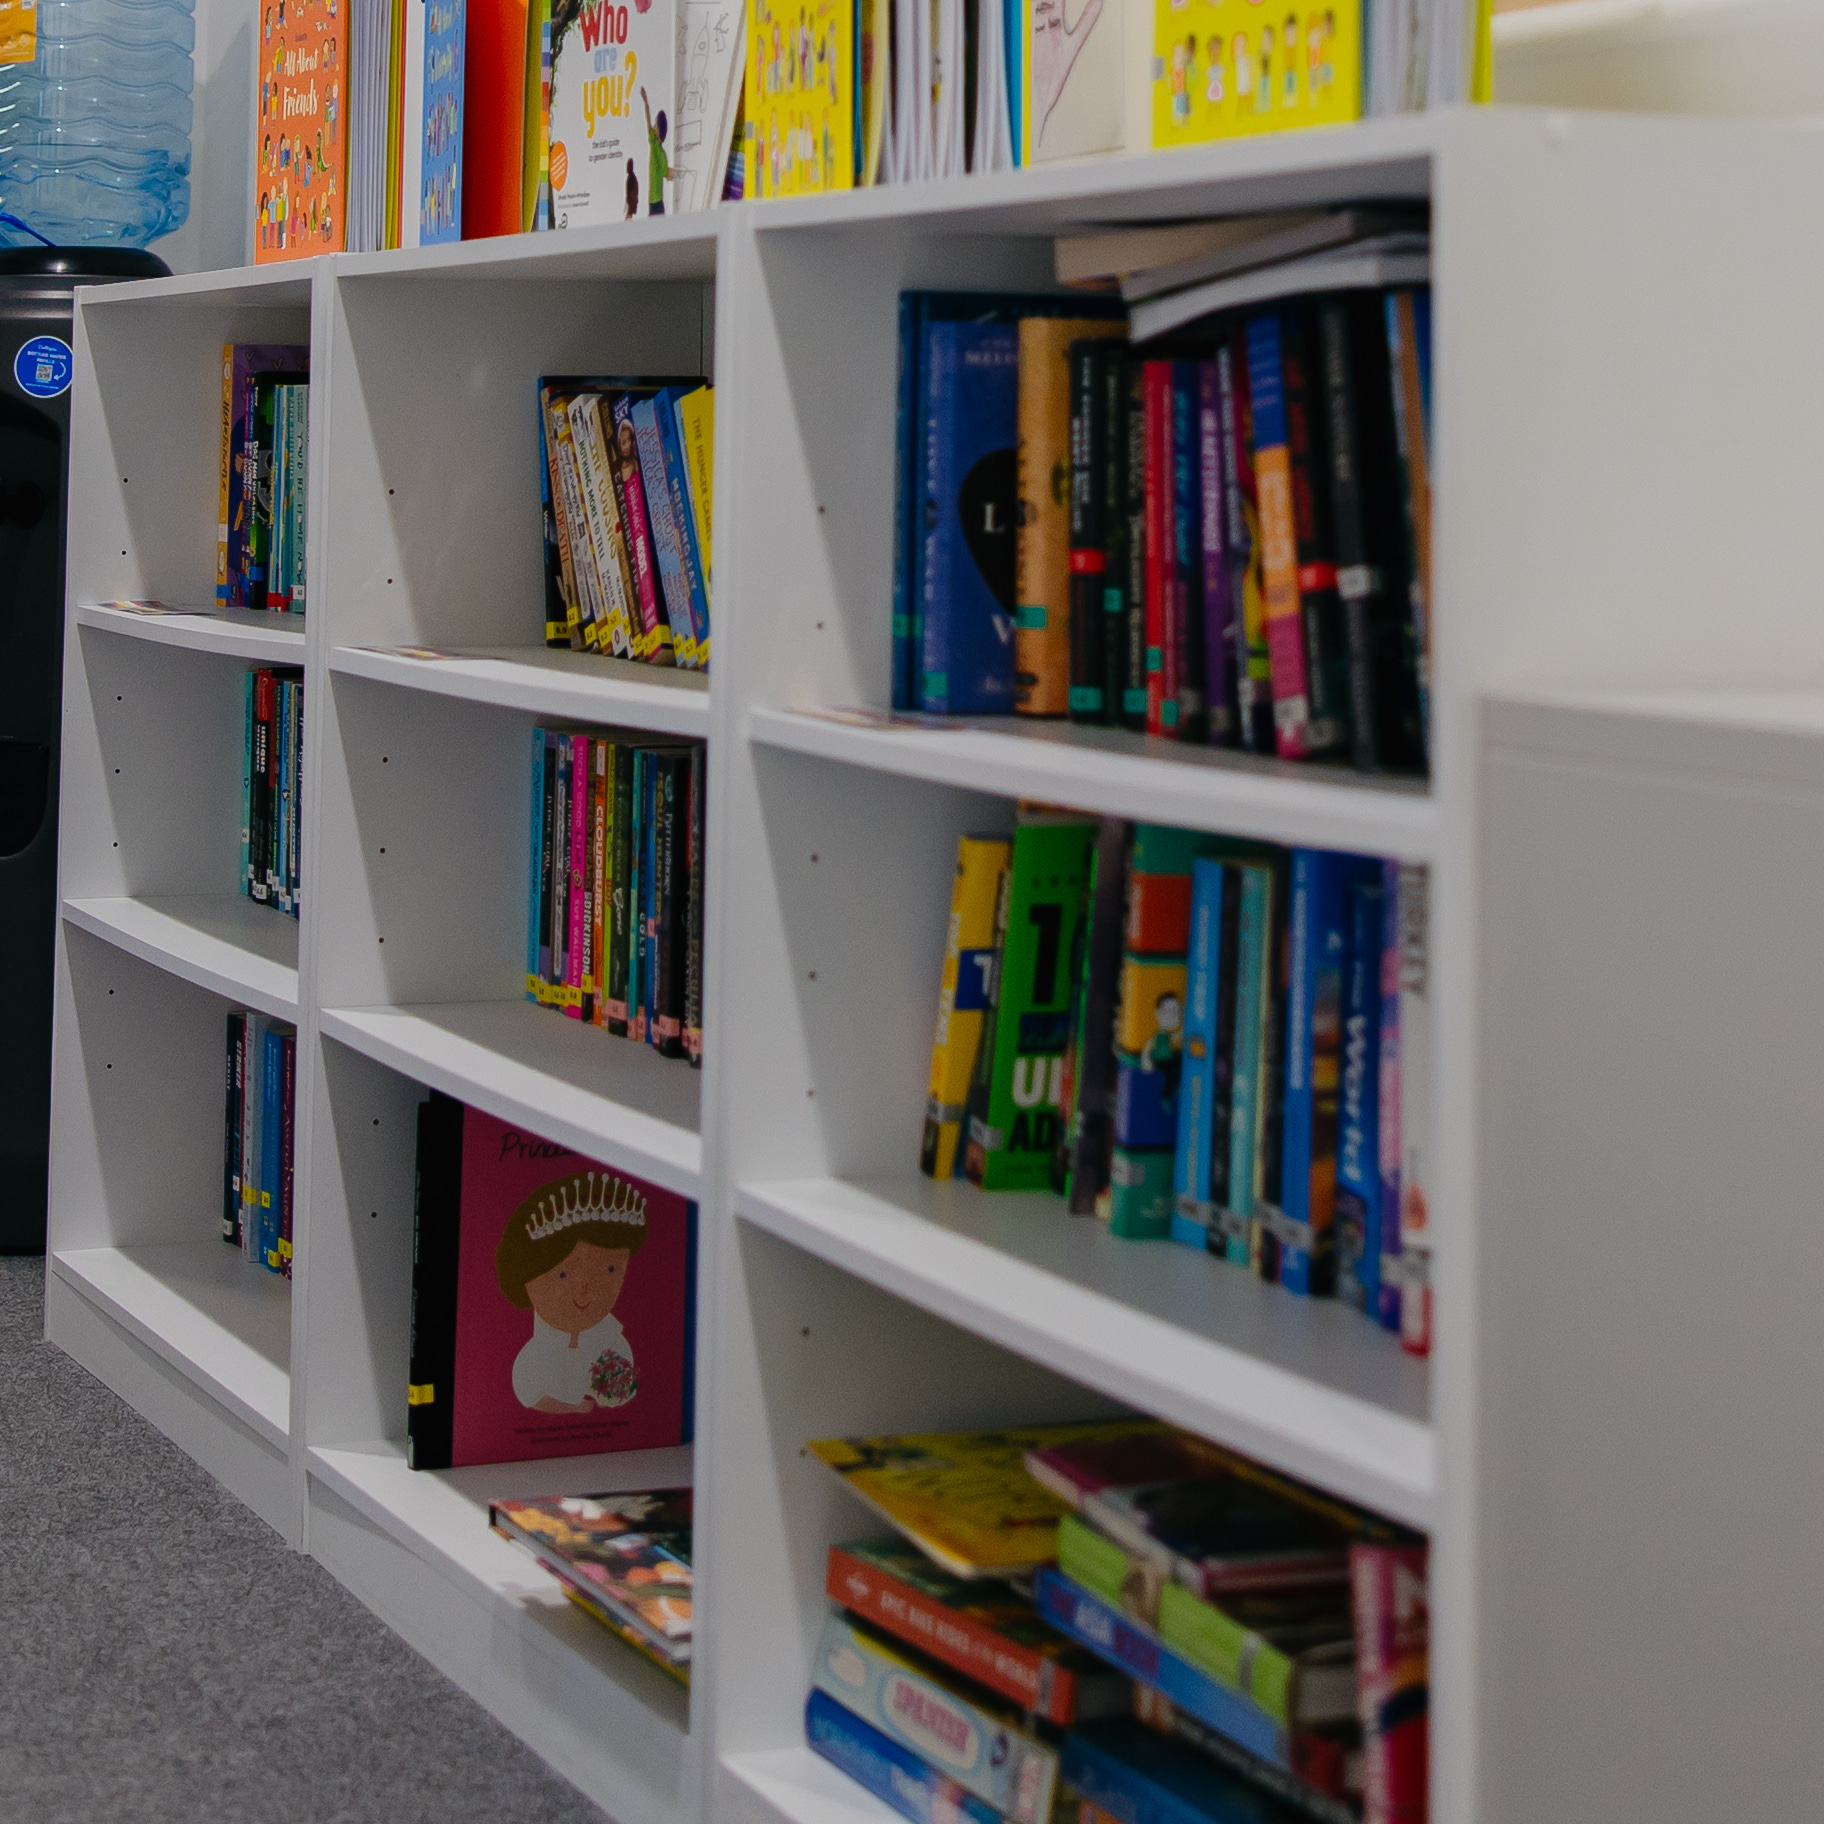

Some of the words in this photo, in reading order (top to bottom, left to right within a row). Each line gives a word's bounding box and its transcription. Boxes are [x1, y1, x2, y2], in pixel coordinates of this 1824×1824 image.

[285, 50, 296, 77] All
[297, 45, 319, 76] About
[594, 46, 618, 74] are
[283, 78, 319, 121] Friends
[583, 50, 638, 139] you?
[222, 400, 231, 492] HEARTSTOPPER
[296, 431, 304, 470] YOU'D
[693, 417, 703, 441] THE
[578, 439, 593, 488] NOTHING
[696, 444, 708, 494] HUNGER
[296, 477, 304, 495] BE
[587, 489, 599, 518] MORE
[650, 426, 668, 500] JESSICA'S
[661, 502, 678, 554] GHOST
[296, 503, 304, 544] HOME
[549, 457, 562, 495] KISS
[556, 508, 570, 565] DEATH
[593, 521, 602, 535] TO
[598, 478, 617, 560] COUSINS
[615, 471, 634, 552] CATCHING
[596, 537, 607, 561] TELL
[670, 476, 698, 590] MOCKINGJAY
[296, 551, 304, 586] NOW
[635, 535, 649, 579] MODEL
[259, 726, 267, 774] unique
[576, 745, 585, 777] SUCH
[575, 790, 584, 830] GOOD
[595, 805, 606, 927] CLOUDBURST
[572, 898, 581, 922] SUE
[571, 926, 580, 988] WALLMAN
[581, 900, 592, 976] DICKINSON
